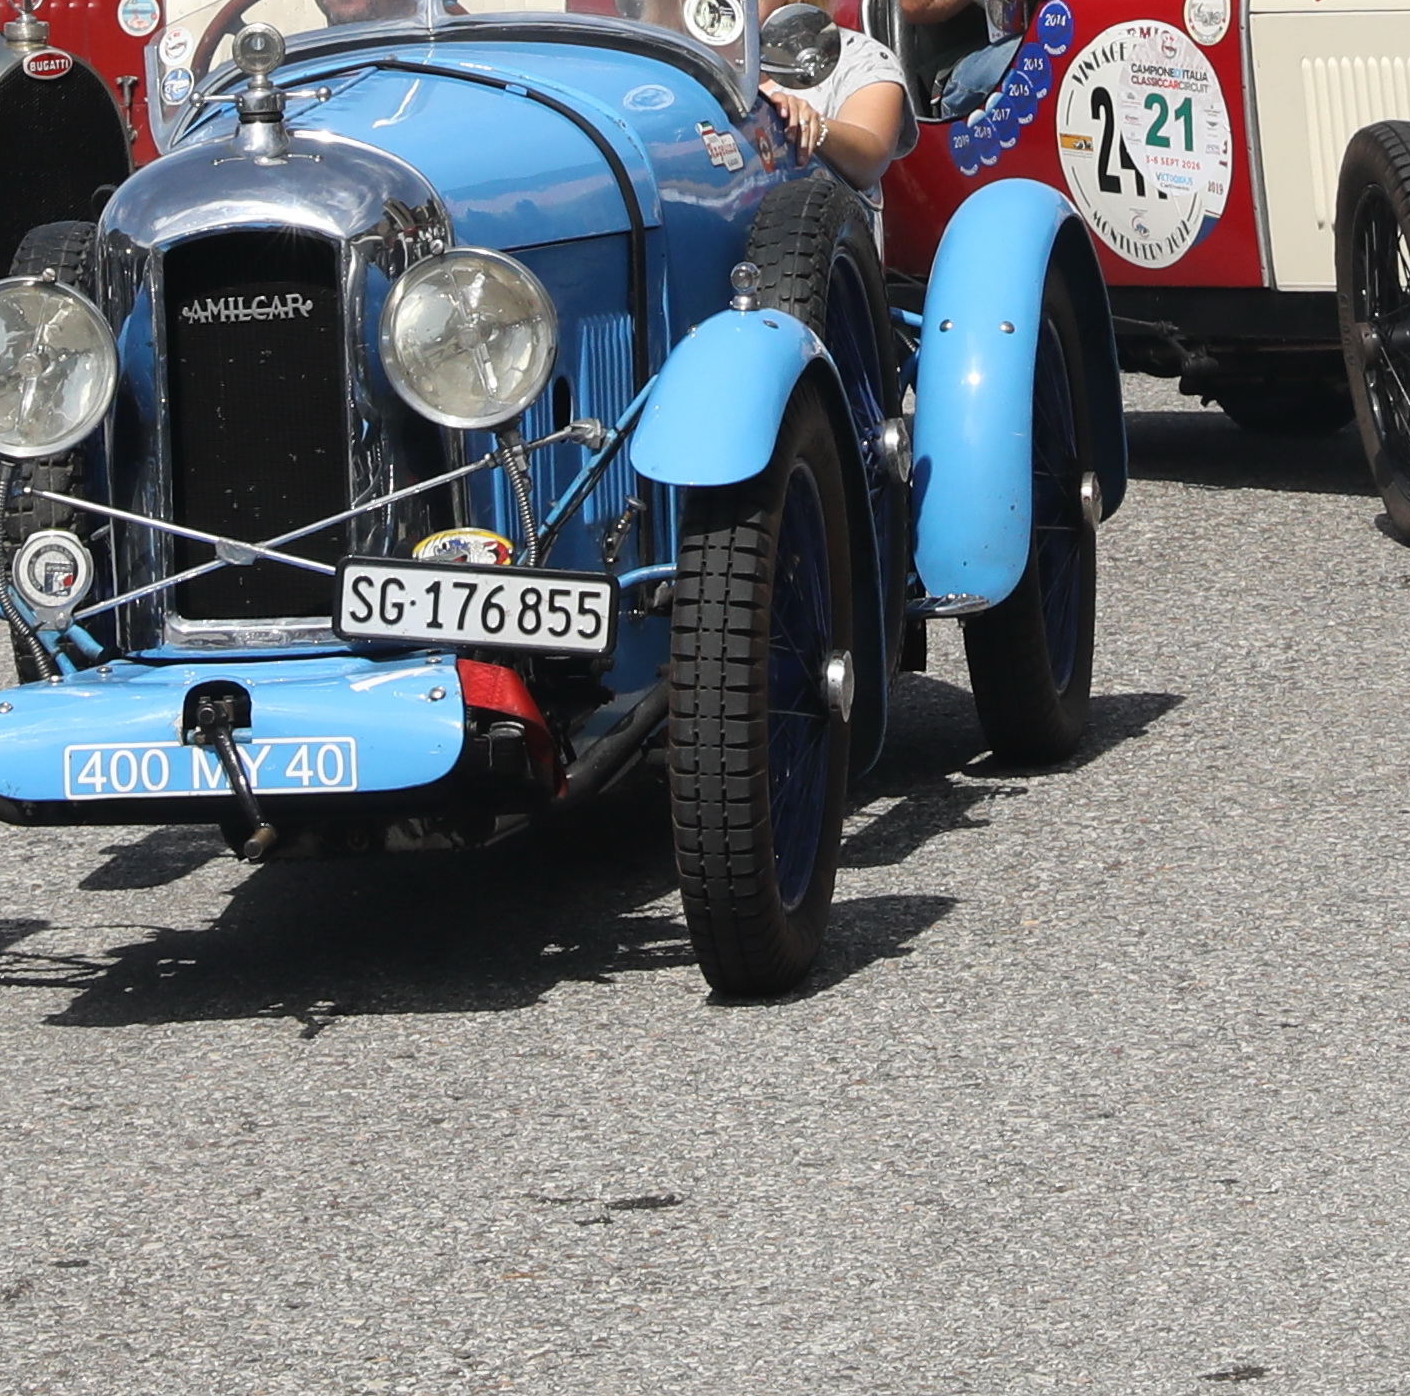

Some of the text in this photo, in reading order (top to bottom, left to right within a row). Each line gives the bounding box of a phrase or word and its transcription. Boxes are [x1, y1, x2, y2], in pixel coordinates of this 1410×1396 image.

[1044, 14, 1067, 27] 2014
[29, 53, 70, 72] BUGATTI
[1023, 58, 1044, 71] 2015
[1072, 41, 1129, 87] VINTAGE
[991, 108, 1011, 121] 2017
[1144, 93, 1194, 152] 21
[953, 135, 970, 149] 2019
[1160, 156, 1180, 168] SEPT
[1181, 160, 1201, 171] 2026
[187, 293, 311, 324] AMILCAR
[77, 743, 344, 794] 400 MY 40
